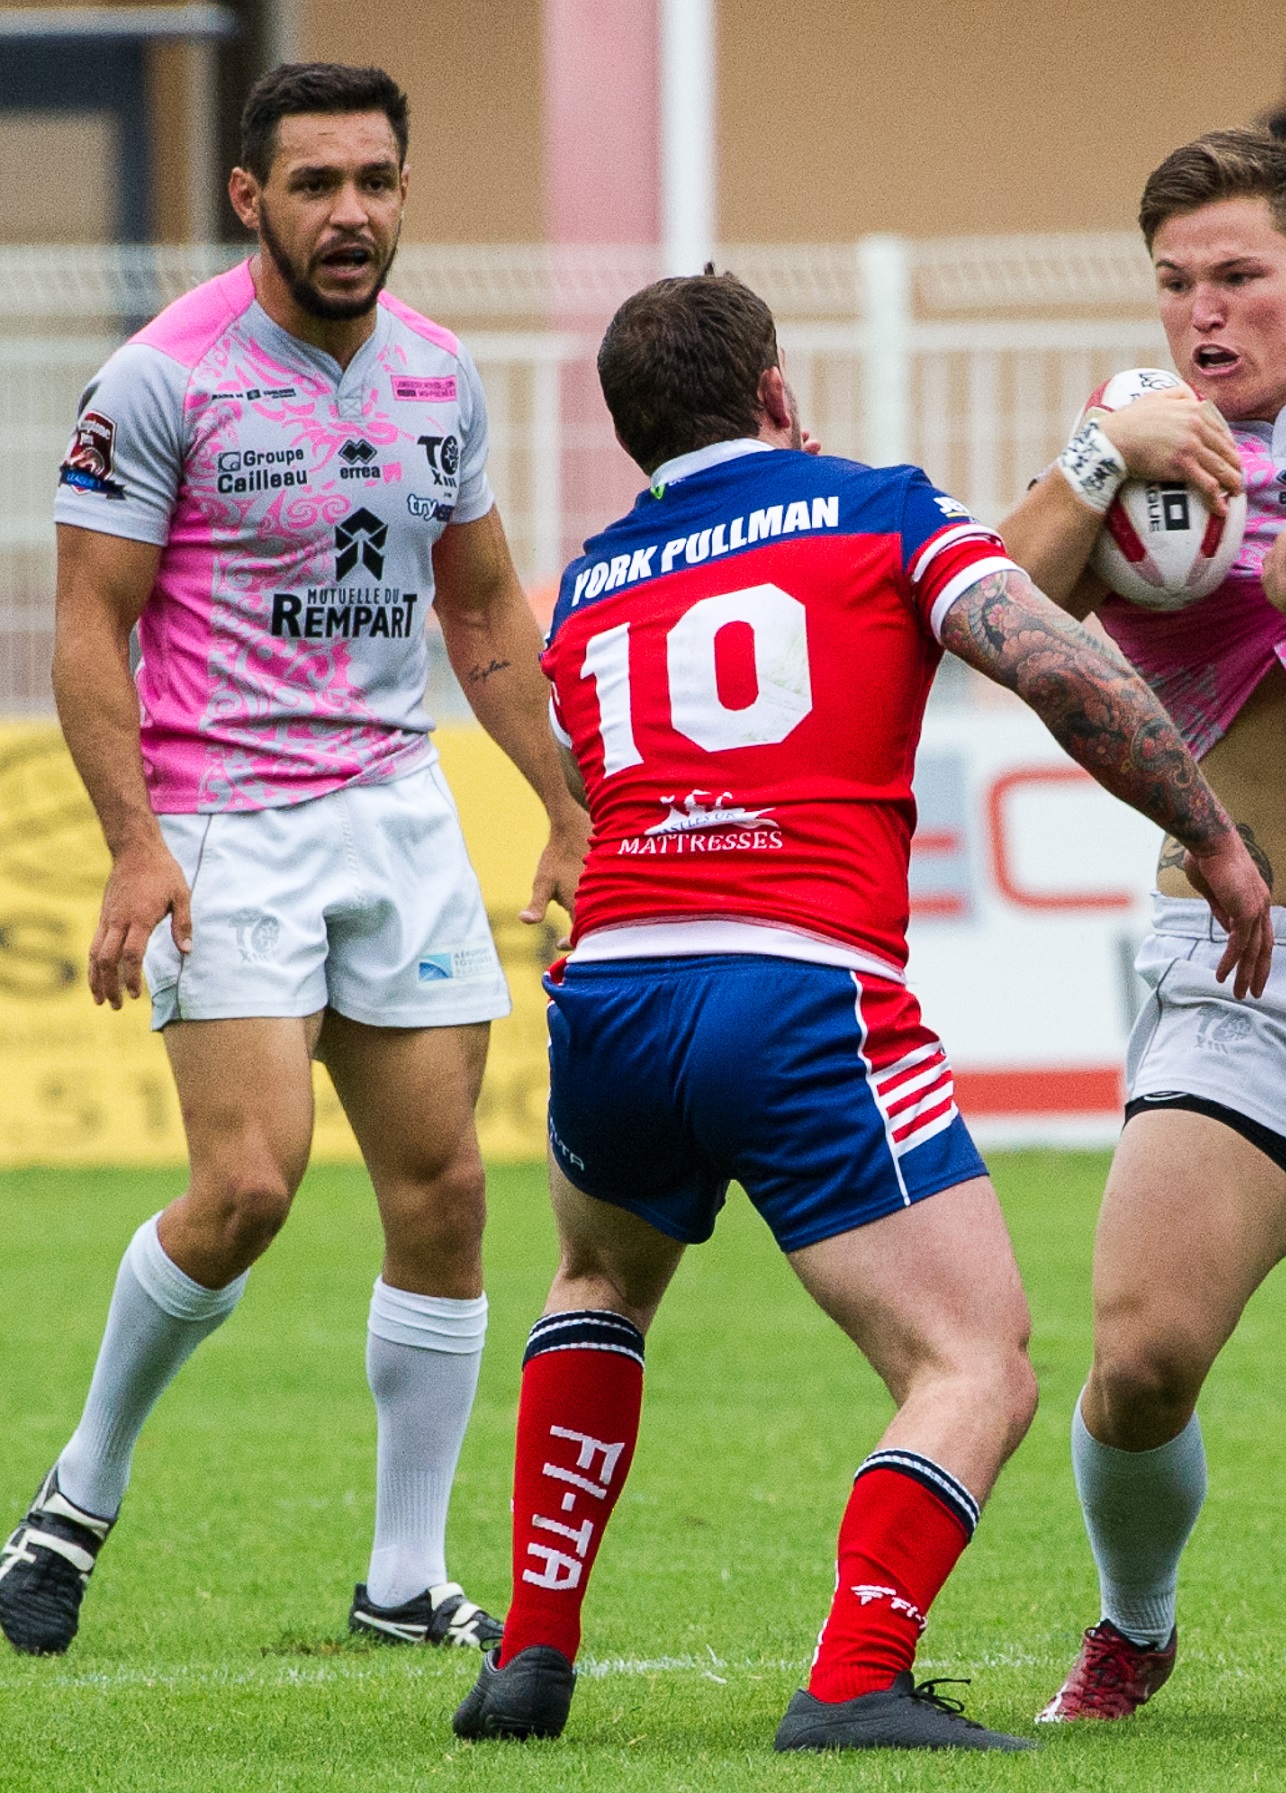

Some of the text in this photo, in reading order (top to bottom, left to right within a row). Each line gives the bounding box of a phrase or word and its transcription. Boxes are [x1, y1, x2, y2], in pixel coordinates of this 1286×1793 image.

[243, 448, 304, 467] Groupe
[217, 469, 308, 494] Cailleau
[340, 466, 381, 479] errea
[572, 496, 839, 607] YORK PULLMAN
[307, 587, 399, 604] MUTUELLE DU
[271, 593, 418, 639] REMPART
[580, 582, 813, 780] 10
[617, 831, 784, 855] MATTRESSES
[521, 1425, 625, 1590] FI-TA
